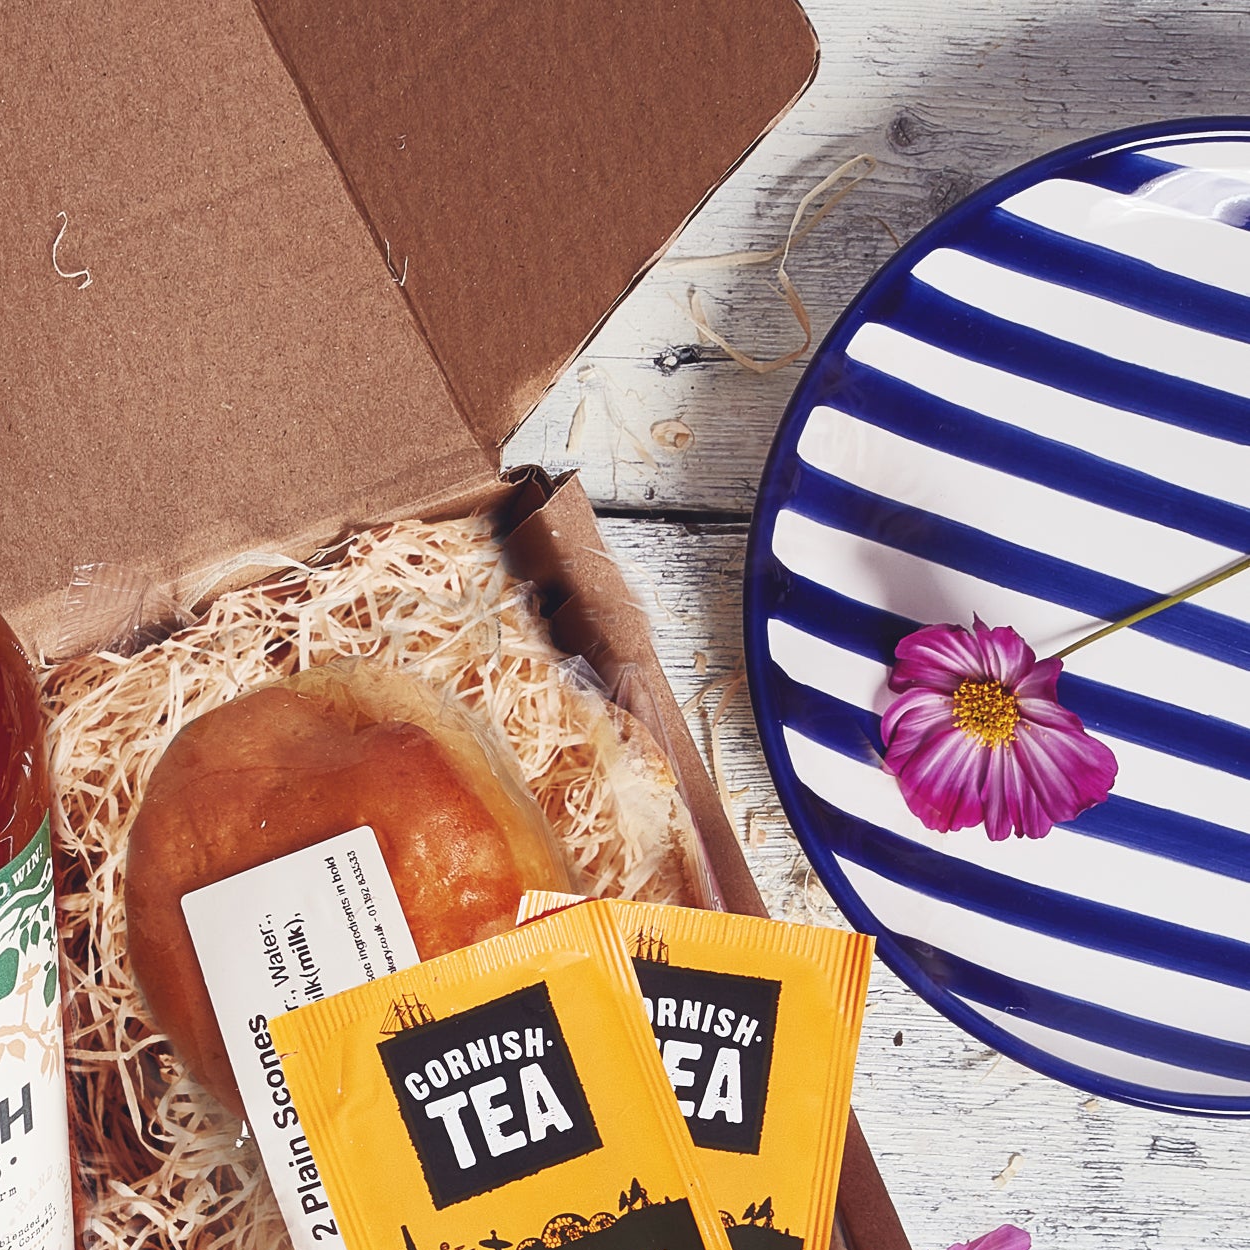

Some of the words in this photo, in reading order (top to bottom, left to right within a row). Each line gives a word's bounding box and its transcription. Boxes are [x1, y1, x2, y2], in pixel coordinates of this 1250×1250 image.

[13, 843, 45, 888] WIN!
[336, 884, 346, 897] in
[283, 913, 325, 1002] ilk(milk),
[248, 1014, 300, 1130] Scones
[655, 1039, 743, 1123] EA
[426, 1062, 574, 1170] TEA
[288, 1135, 331, 1214] Plain
[0, 1216, 41, 1248] blended
[44, 1202, 54, 1215] in
[18, 1208, 58, 1248] Cornwall
[312, 1218, 338, 1241] 2
